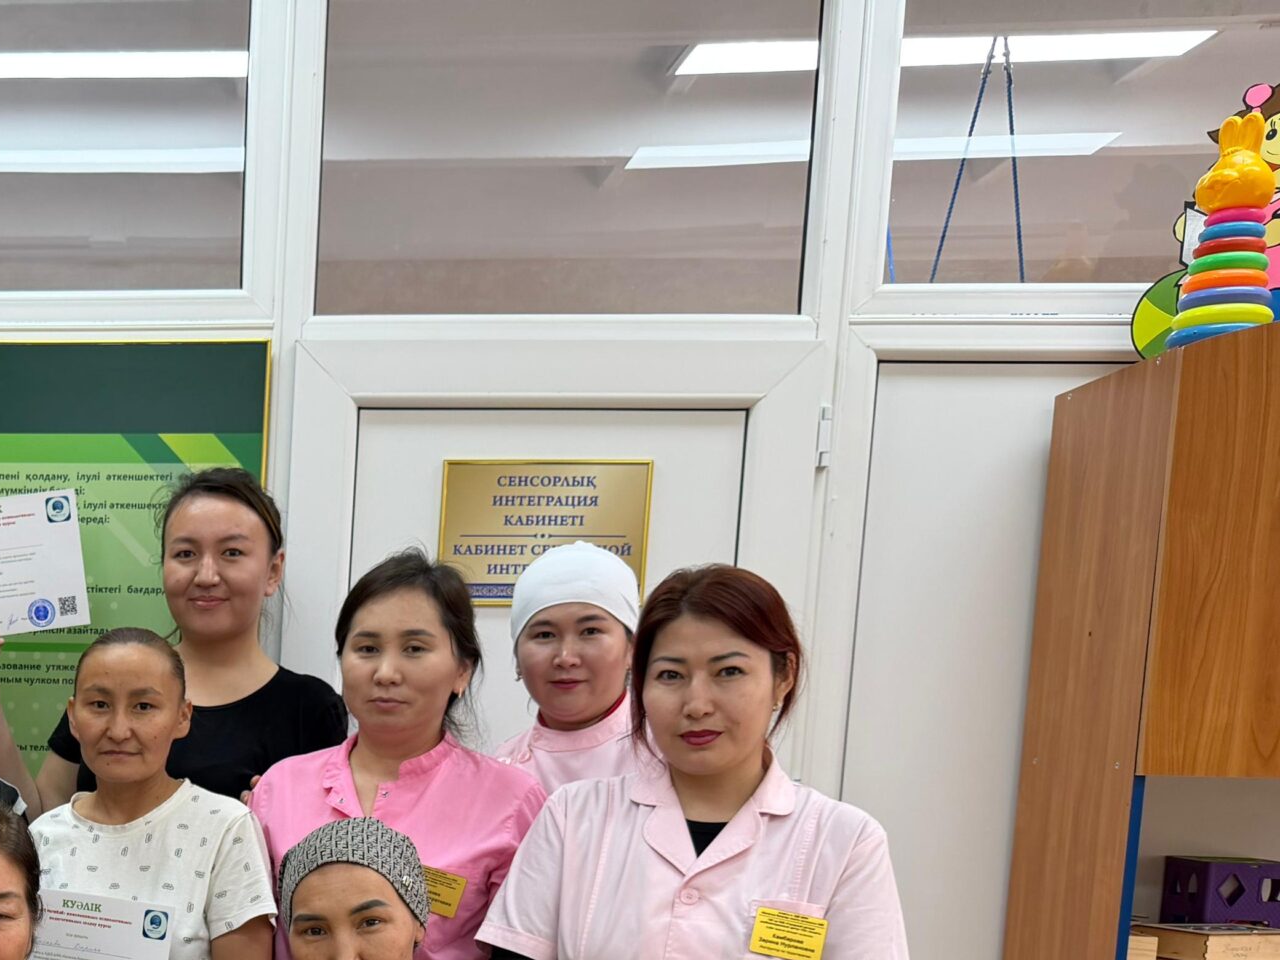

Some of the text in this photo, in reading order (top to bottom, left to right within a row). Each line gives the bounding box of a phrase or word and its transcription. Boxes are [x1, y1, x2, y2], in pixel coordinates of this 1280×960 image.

[24, 473, 70, 483] қолдану,
[75, 471, 101, 483] ілулі
[104, 472, 173, 482] әткеншектегі
[497, 475, 596, 490] СЕНСОРЛЫҚ
[492, 495, 599, 508] ИНТЕГРАЦИЯ
[503, 515, 584, 526] КАБИНЕТІ
[453, 544, 527, 556] КАБИНЕТ
[62, 899, 102, 913] КУӘЛІК
